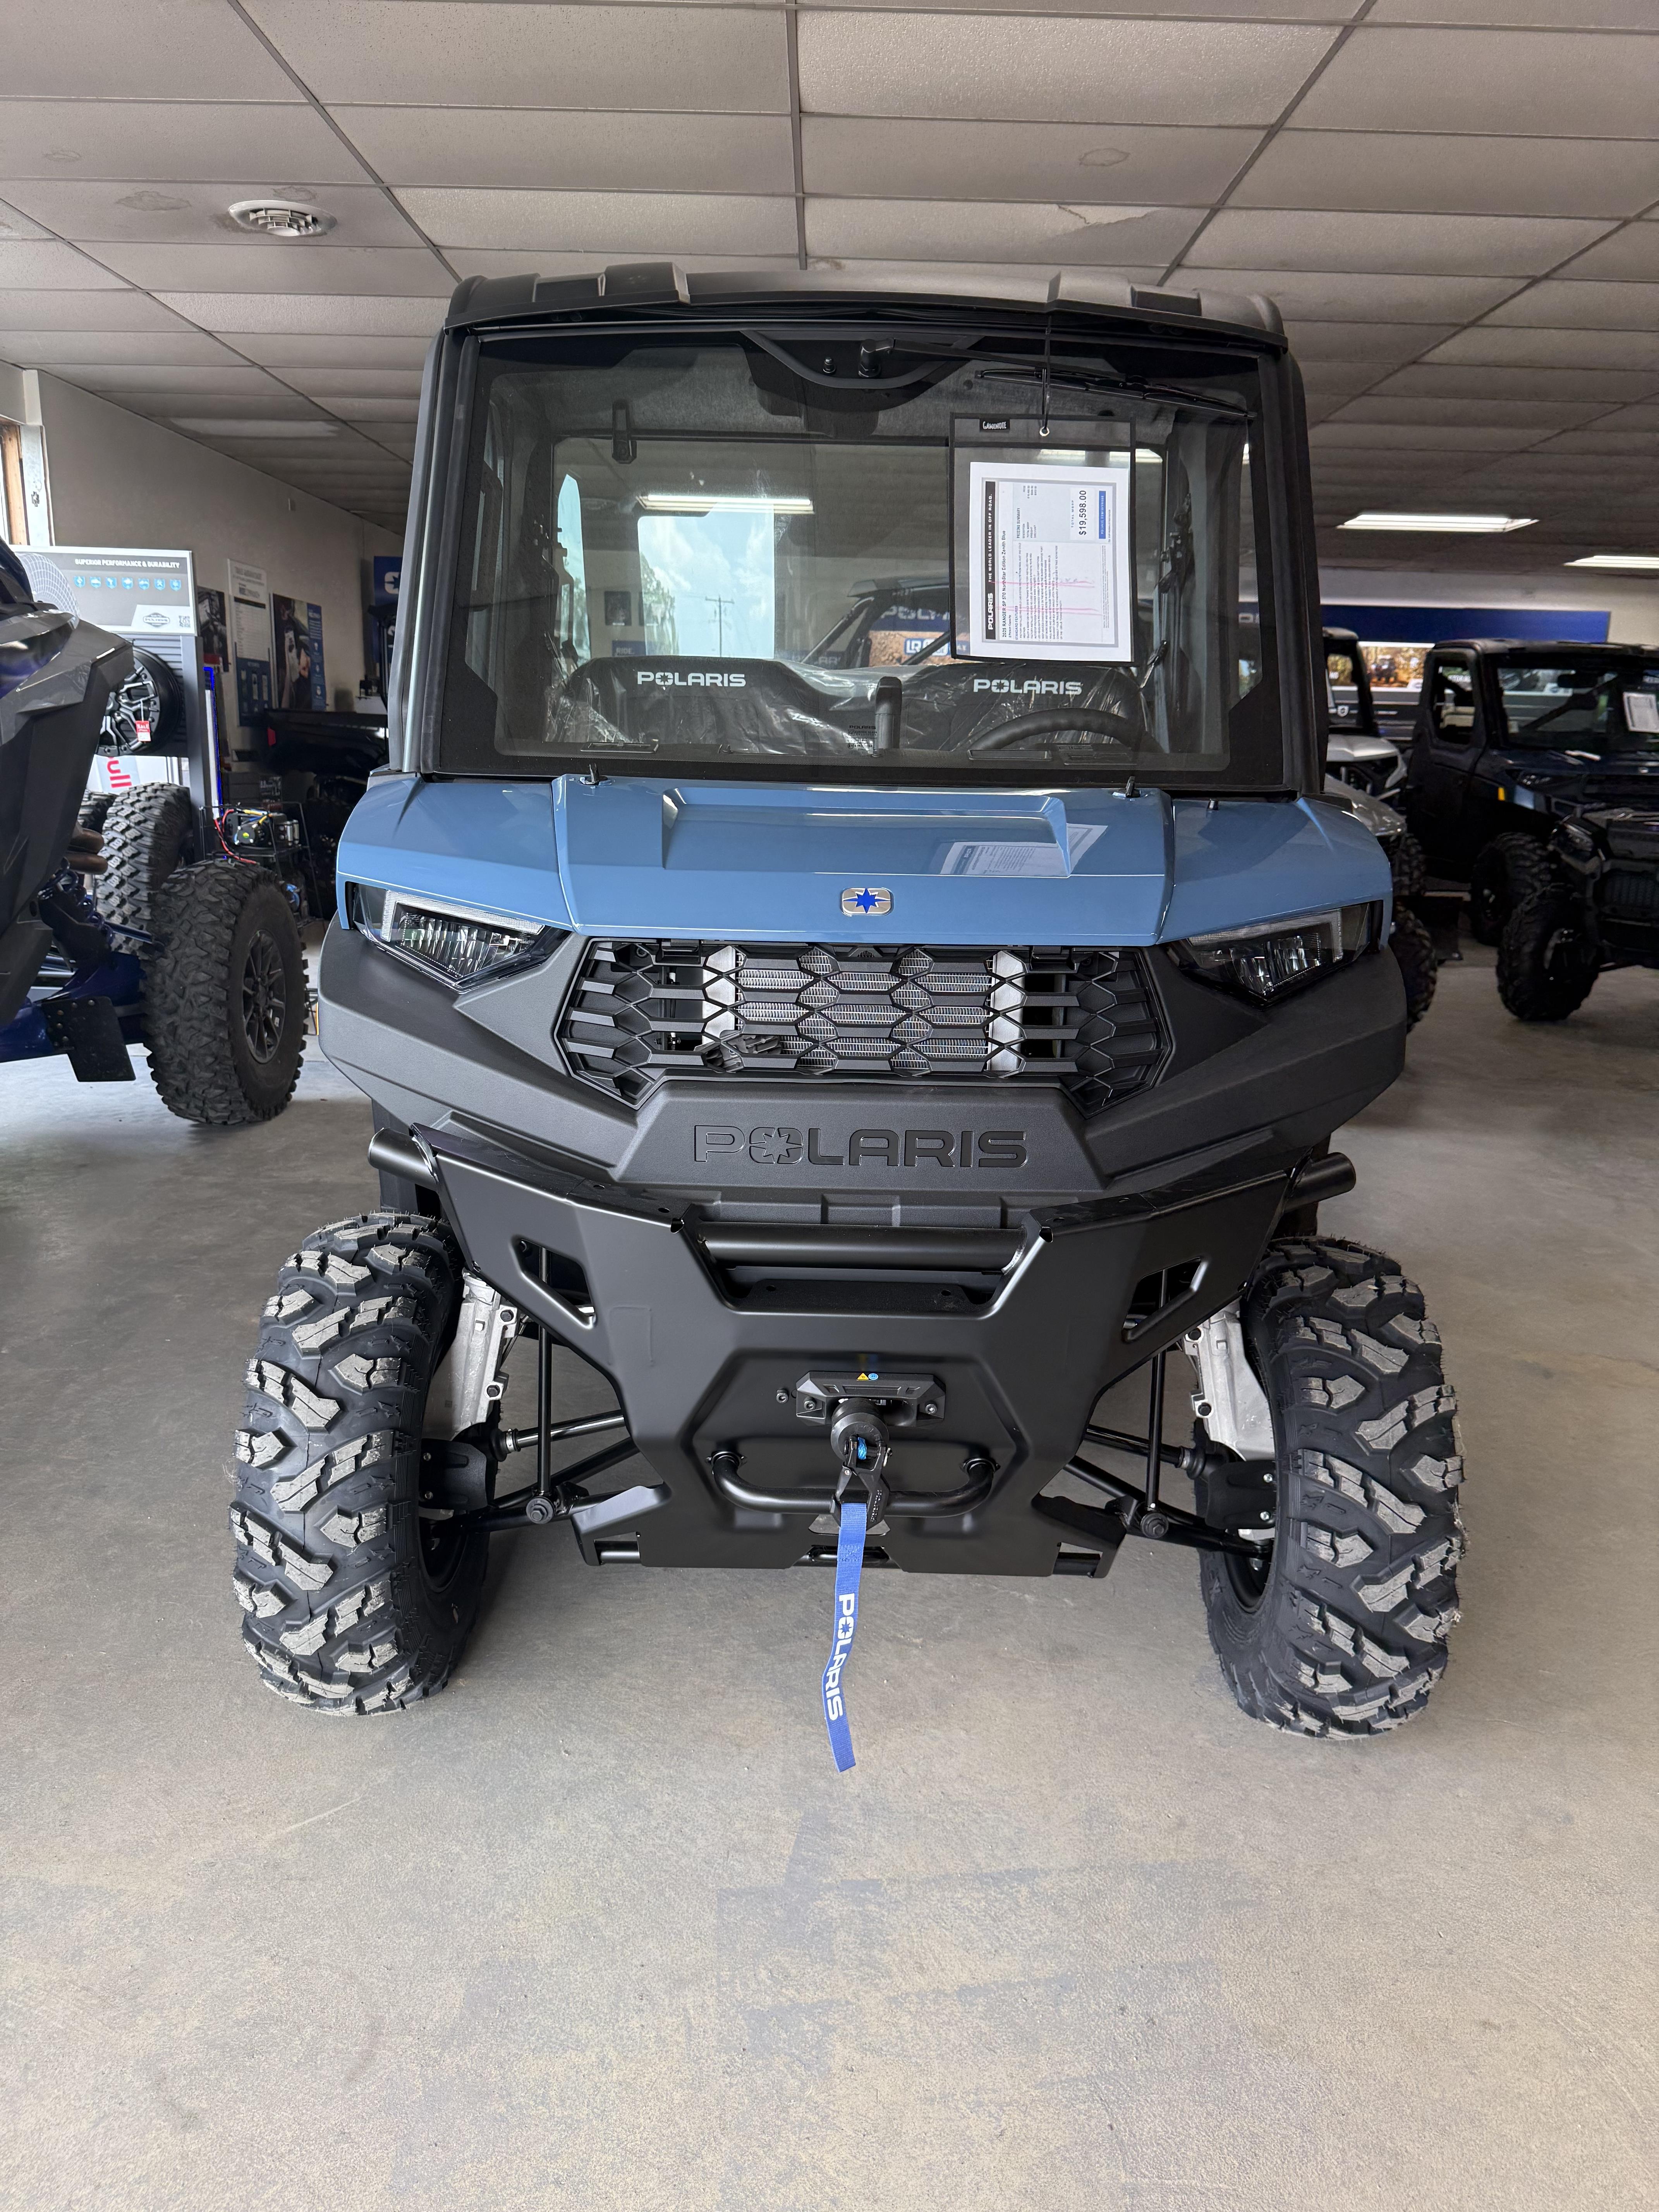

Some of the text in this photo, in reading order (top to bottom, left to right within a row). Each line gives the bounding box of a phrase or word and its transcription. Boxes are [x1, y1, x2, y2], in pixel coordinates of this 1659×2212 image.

[1079, 490, 1087, 535] $19,598.00
[637, 672, 746, 687] POLARIS
[974, 679, 1082, 695] POLARIS
[107, 757, 132, 788] ull
[694, 1125, 1029, 1169] POLARIS
[825, 1593, 855, 1721] POLARIS
